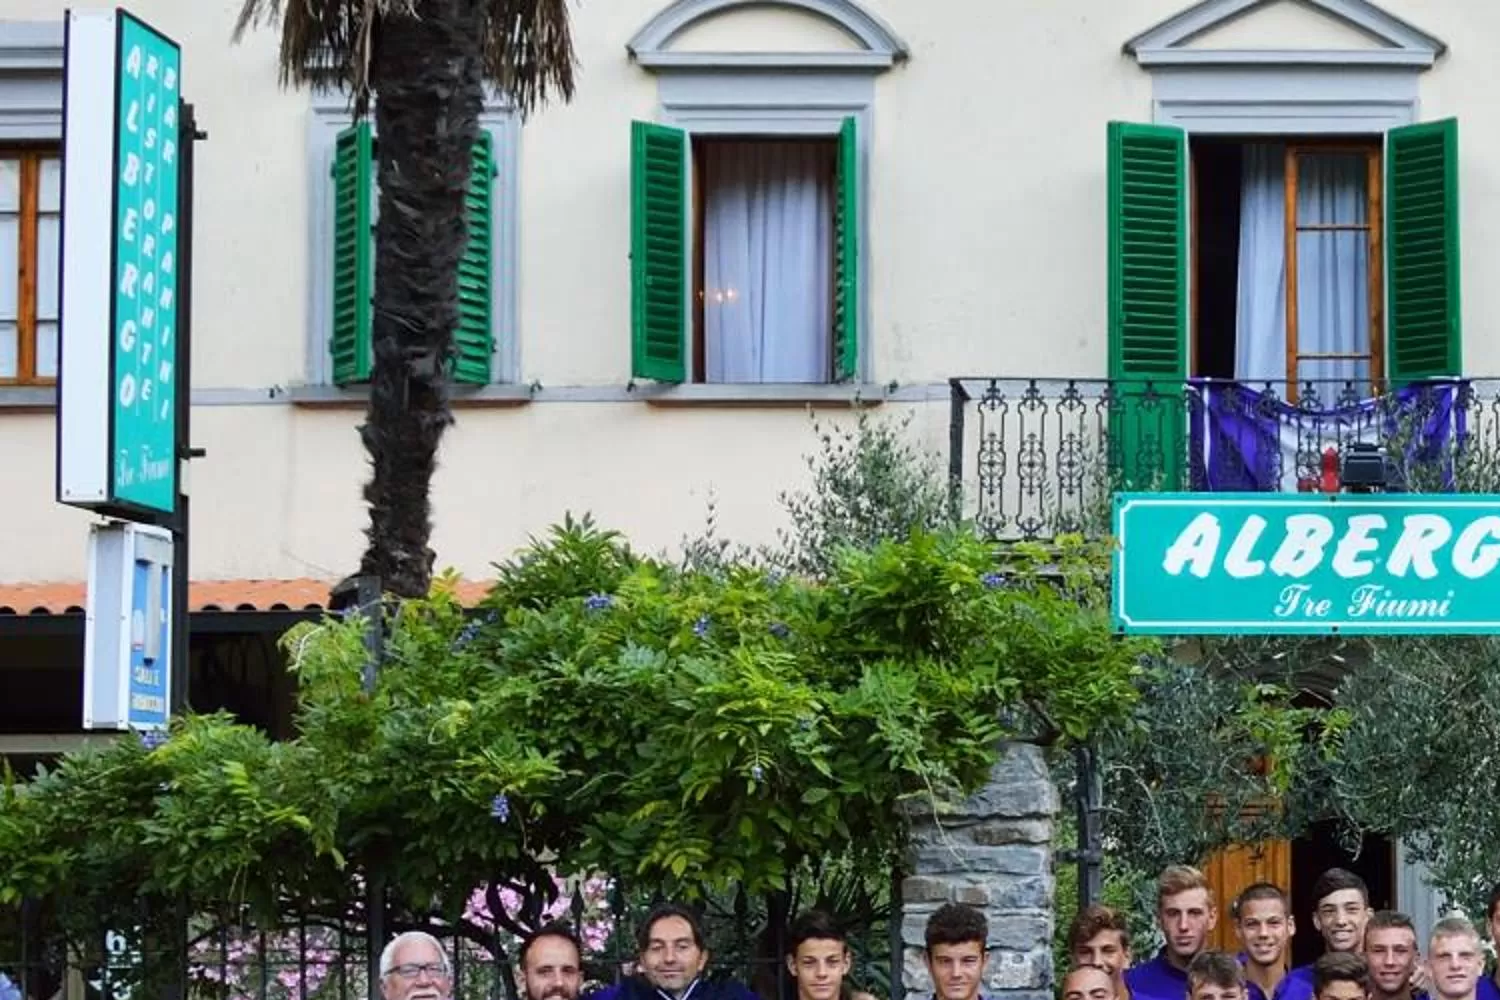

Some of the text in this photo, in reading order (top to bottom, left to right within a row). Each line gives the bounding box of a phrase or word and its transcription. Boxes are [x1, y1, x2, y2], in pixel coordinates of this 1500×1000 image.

[119, 44, 141, 407] ALBERGO
[141, 52, 158, 401] RISTORANTE
[159, 66, 176, 420] BAR PANINI
[1273, 584, 1455, 618] Tre Fiumi
